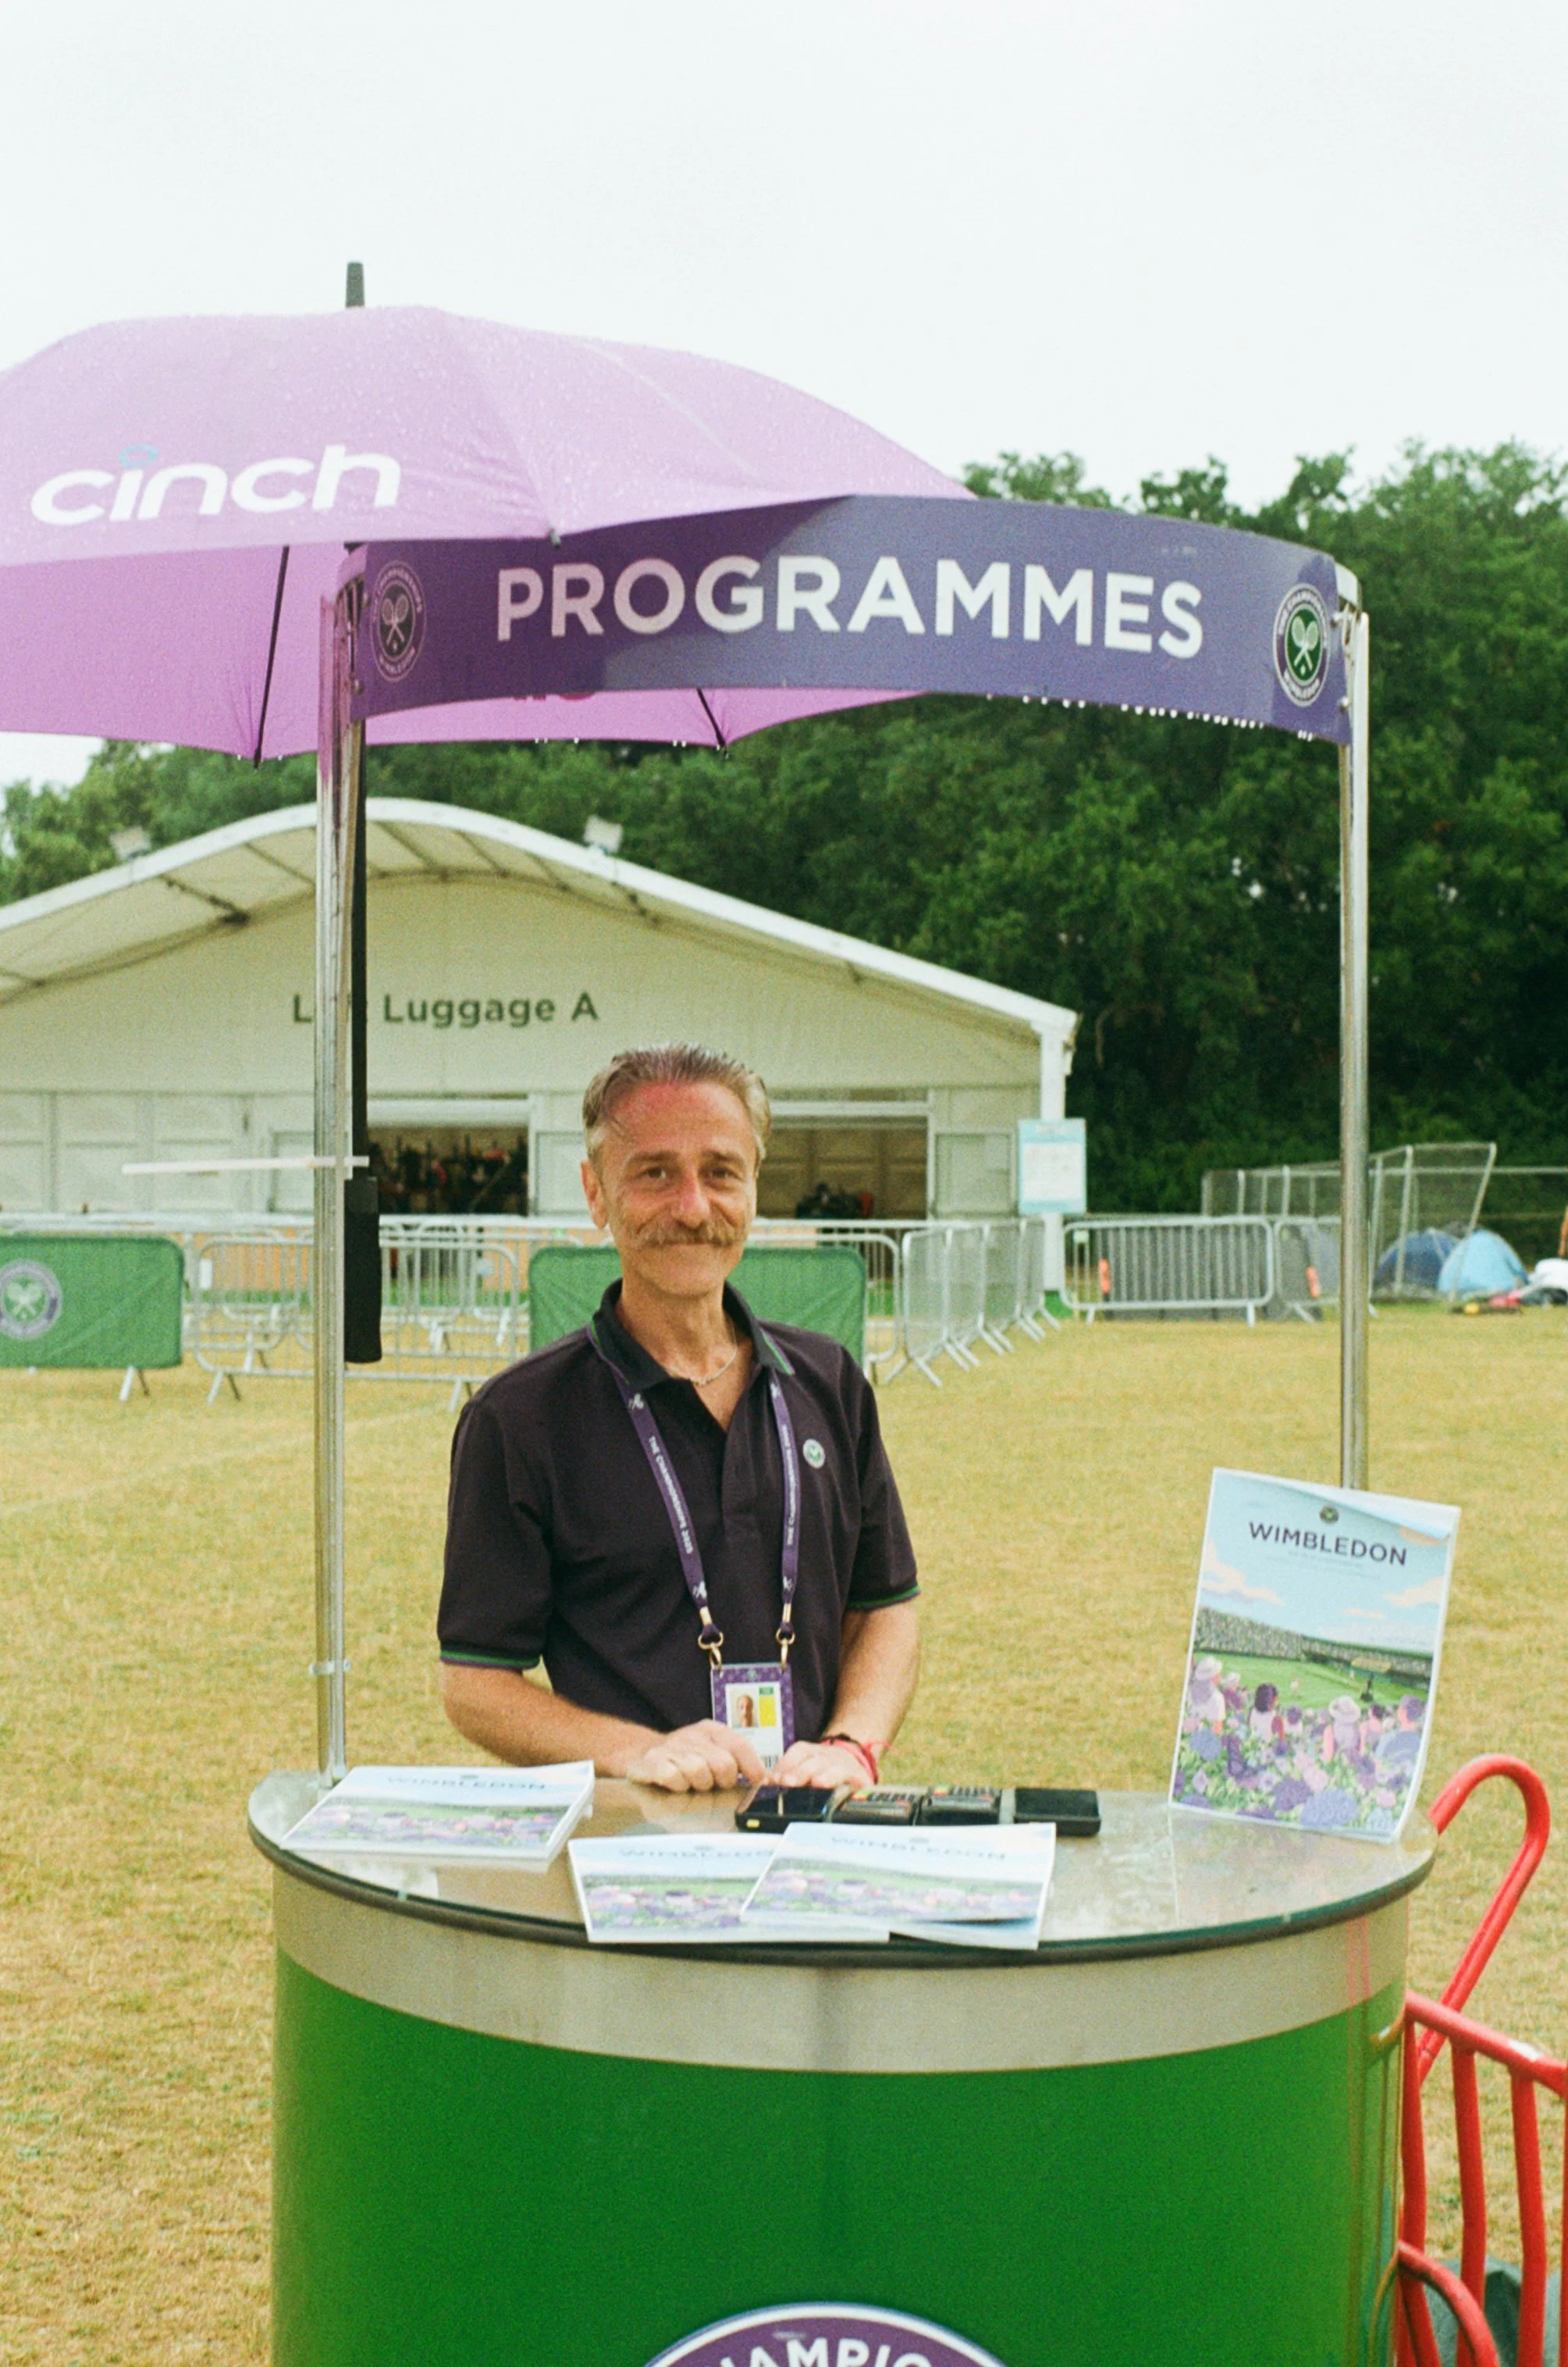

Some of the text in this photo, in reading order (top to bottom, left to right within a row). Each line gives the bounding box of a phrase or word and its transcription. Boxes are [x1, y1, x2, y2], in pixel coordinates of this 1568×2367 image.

[30, 443, 401, 525] cinch
[497, 555, 1204, 659] PROGRAMMES
[383, 993, 556, 1028] Luggage
[571, 991, 599, 1021] A
[1249, 1521, 1407, 1566] WIMBLEDON
